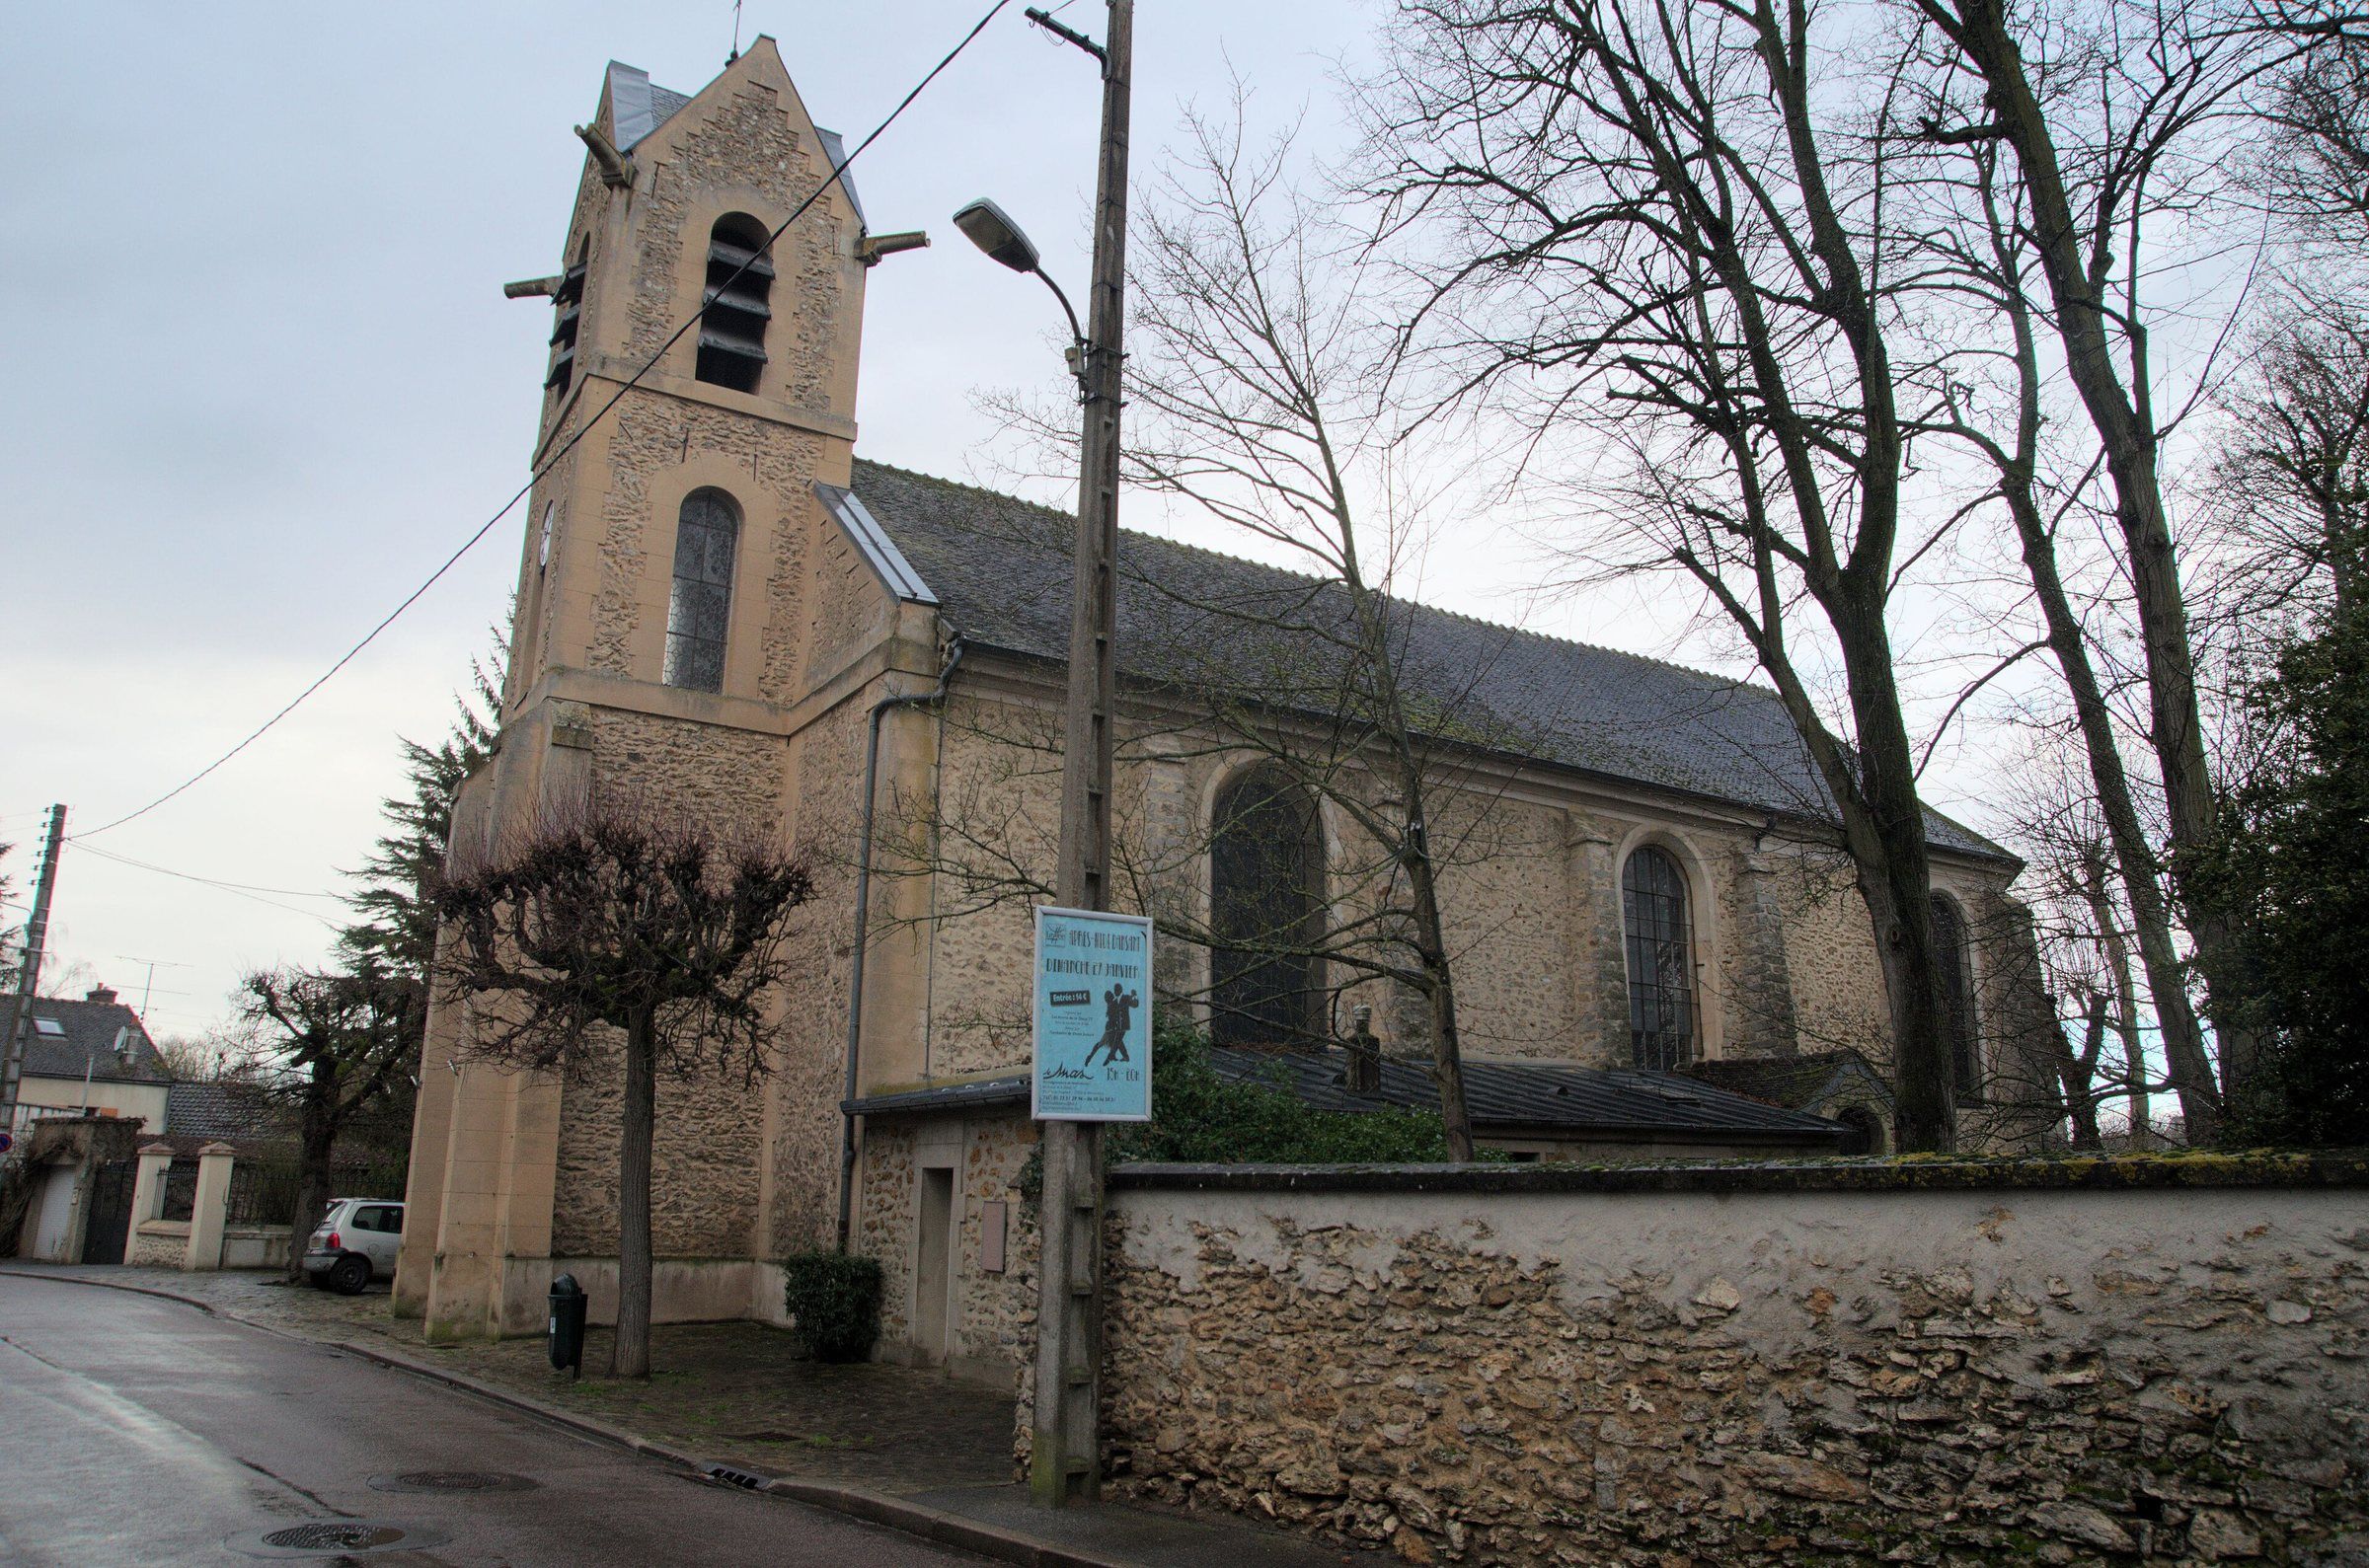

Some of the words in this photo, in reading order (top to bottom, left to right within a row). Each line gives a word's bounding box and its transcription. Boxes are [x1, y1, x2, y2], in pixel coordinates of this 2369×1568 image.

[1112, 933, 1140, 952] DANSANT
[1046, 957, 1090, 976] DIMANCHE
[1092, 961, 1103, 976] 27
[1105, 962, 1140, 979] JANVIER
